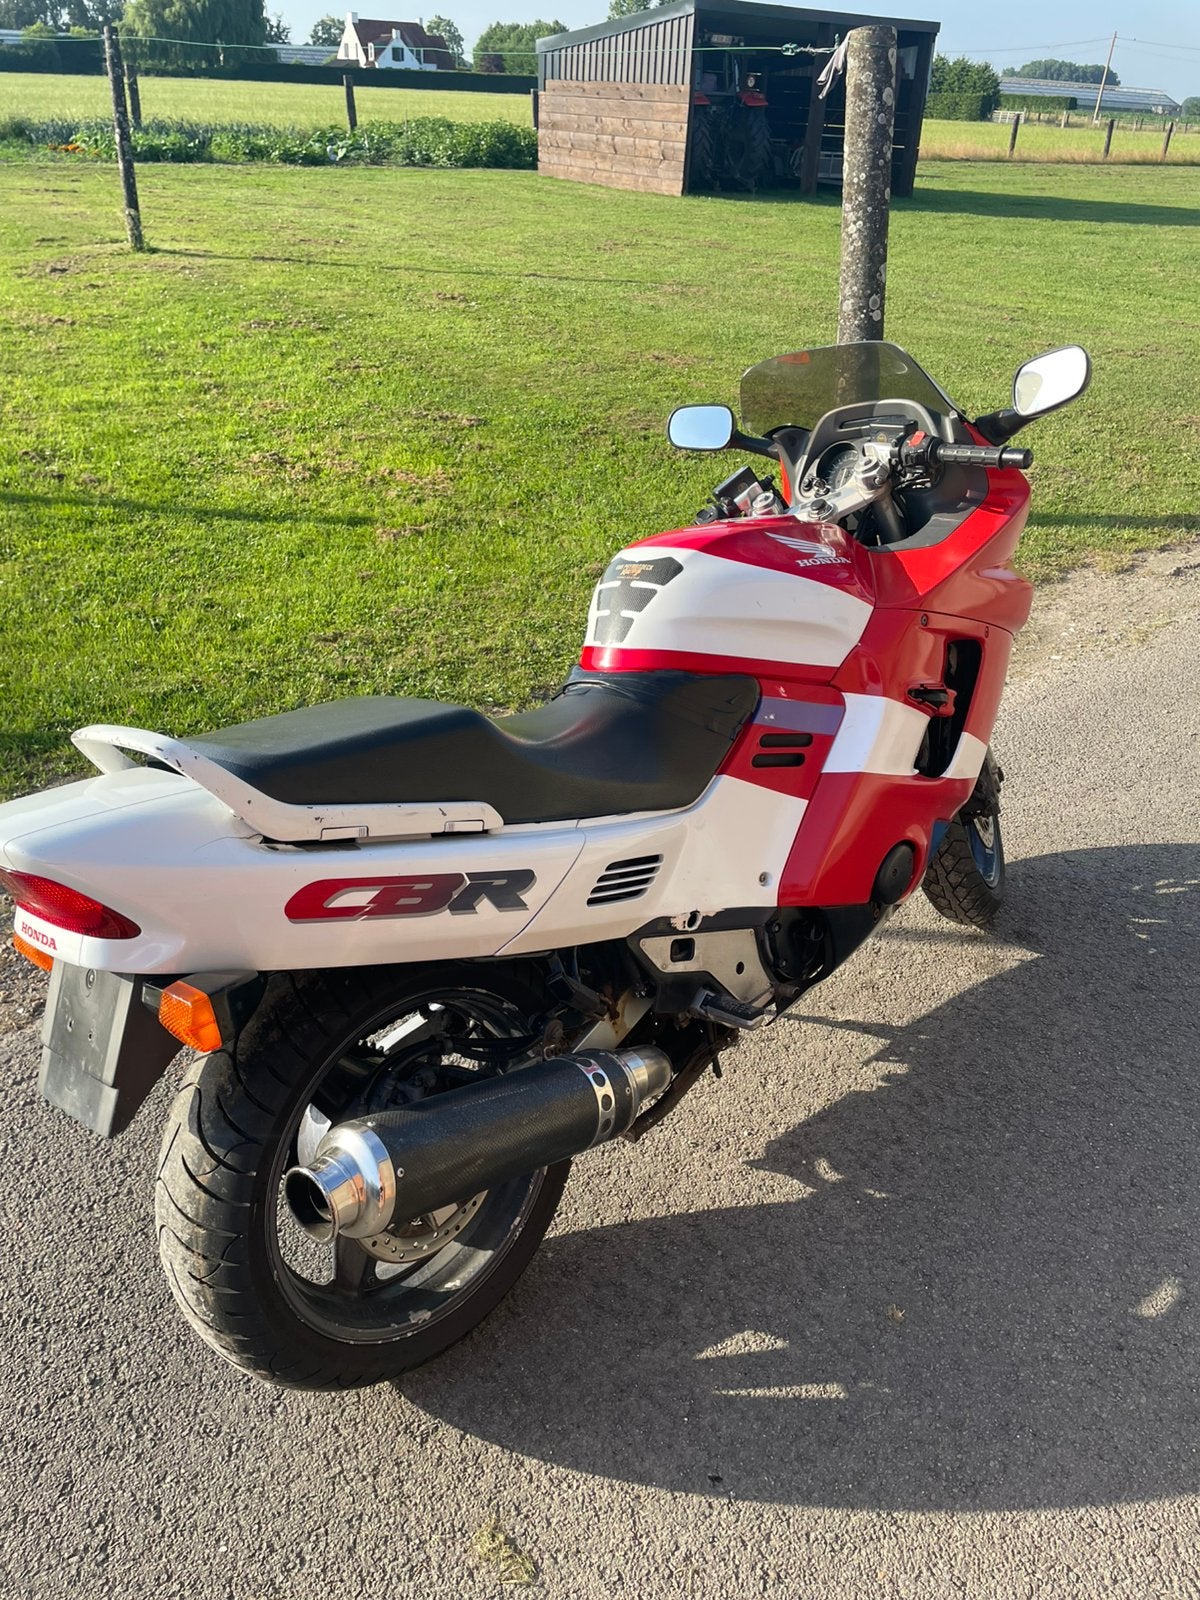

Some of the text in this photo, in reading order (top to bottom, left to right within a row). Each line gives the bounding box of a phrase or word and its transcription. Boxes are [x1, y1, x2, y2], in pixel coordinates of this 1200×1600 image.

[795, 556, 852, 567] HONDA
[284, 868, 538, 924] CBR
[21, 921, 58, 951] HONDA
